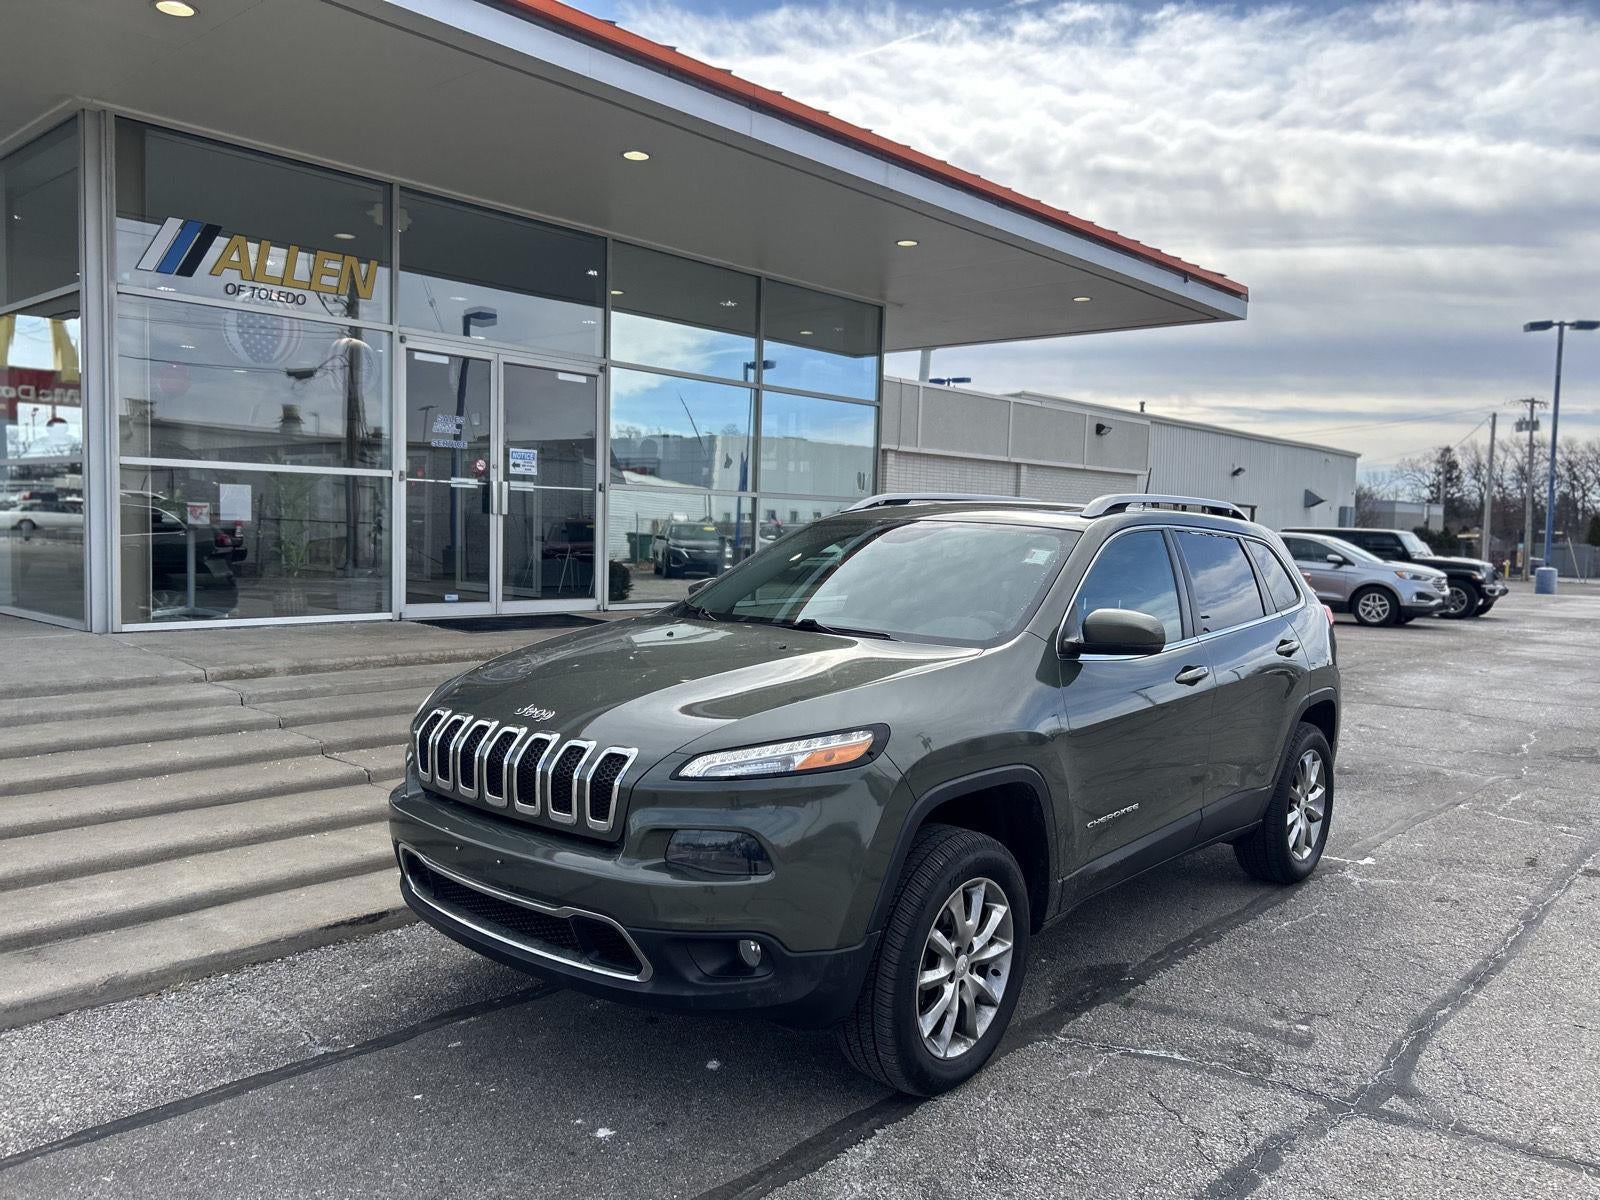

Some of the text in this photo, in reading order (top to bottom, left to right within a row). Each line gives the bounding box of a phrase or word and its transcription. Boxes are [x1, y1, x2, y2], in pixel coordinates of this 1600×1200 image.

[210, 234, 378, 300] ALLEN
[225, 282, 307, 306] OF TOLEDO
[512, 451, 535, 460] NOTICE
[514, 703, 555, 722] Jeep
[1087, 802, 1139, 828] CHEROKEE
